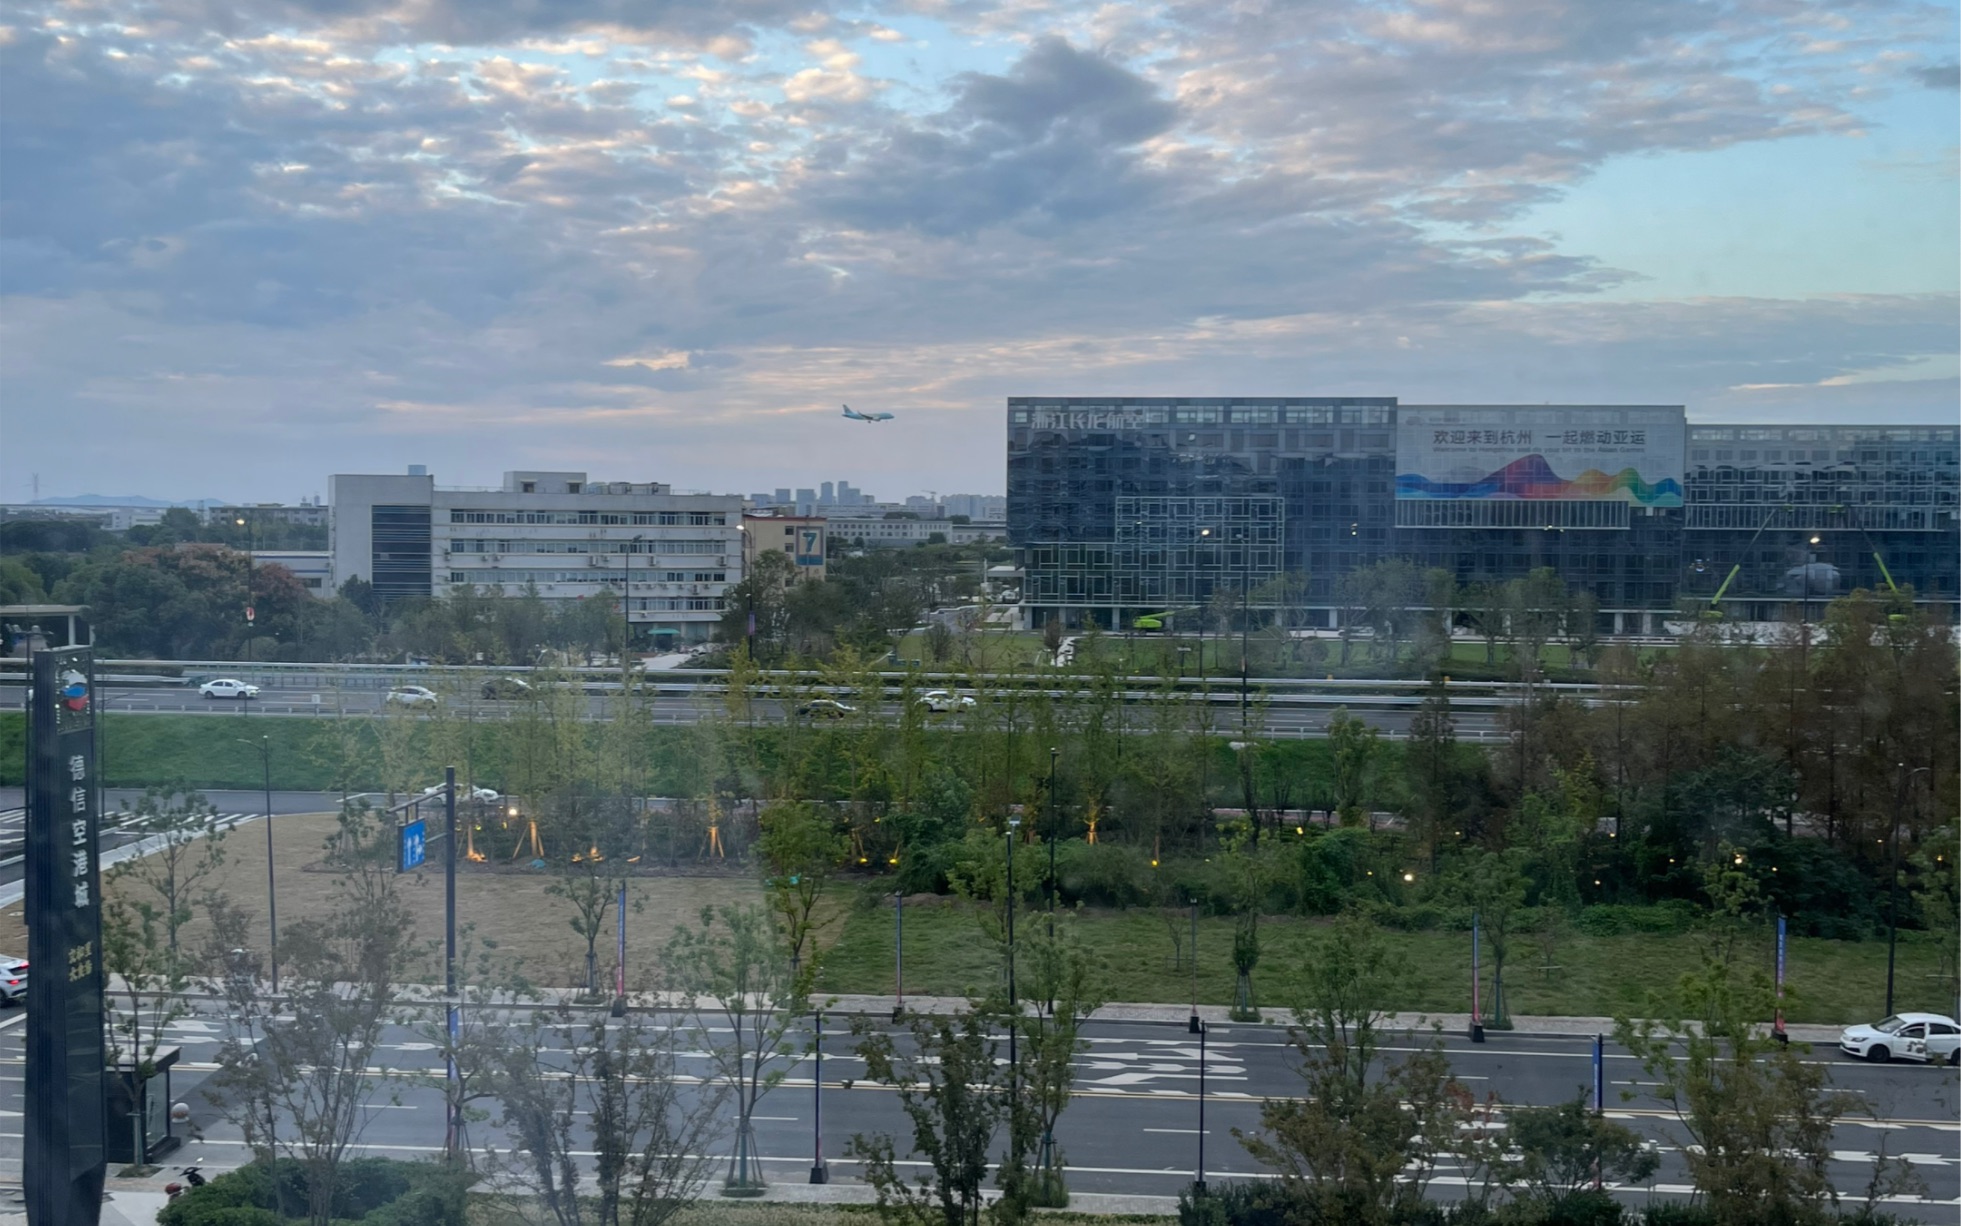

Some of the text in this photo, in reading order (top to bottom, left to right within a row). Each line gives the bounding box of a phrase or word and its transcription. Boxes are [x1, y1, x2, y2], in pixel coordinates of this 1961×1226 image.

[1433, 430, 1646, 445] 欢迎来到杭州 一起燃动亚运
[803, 532, 817, 552] 7
